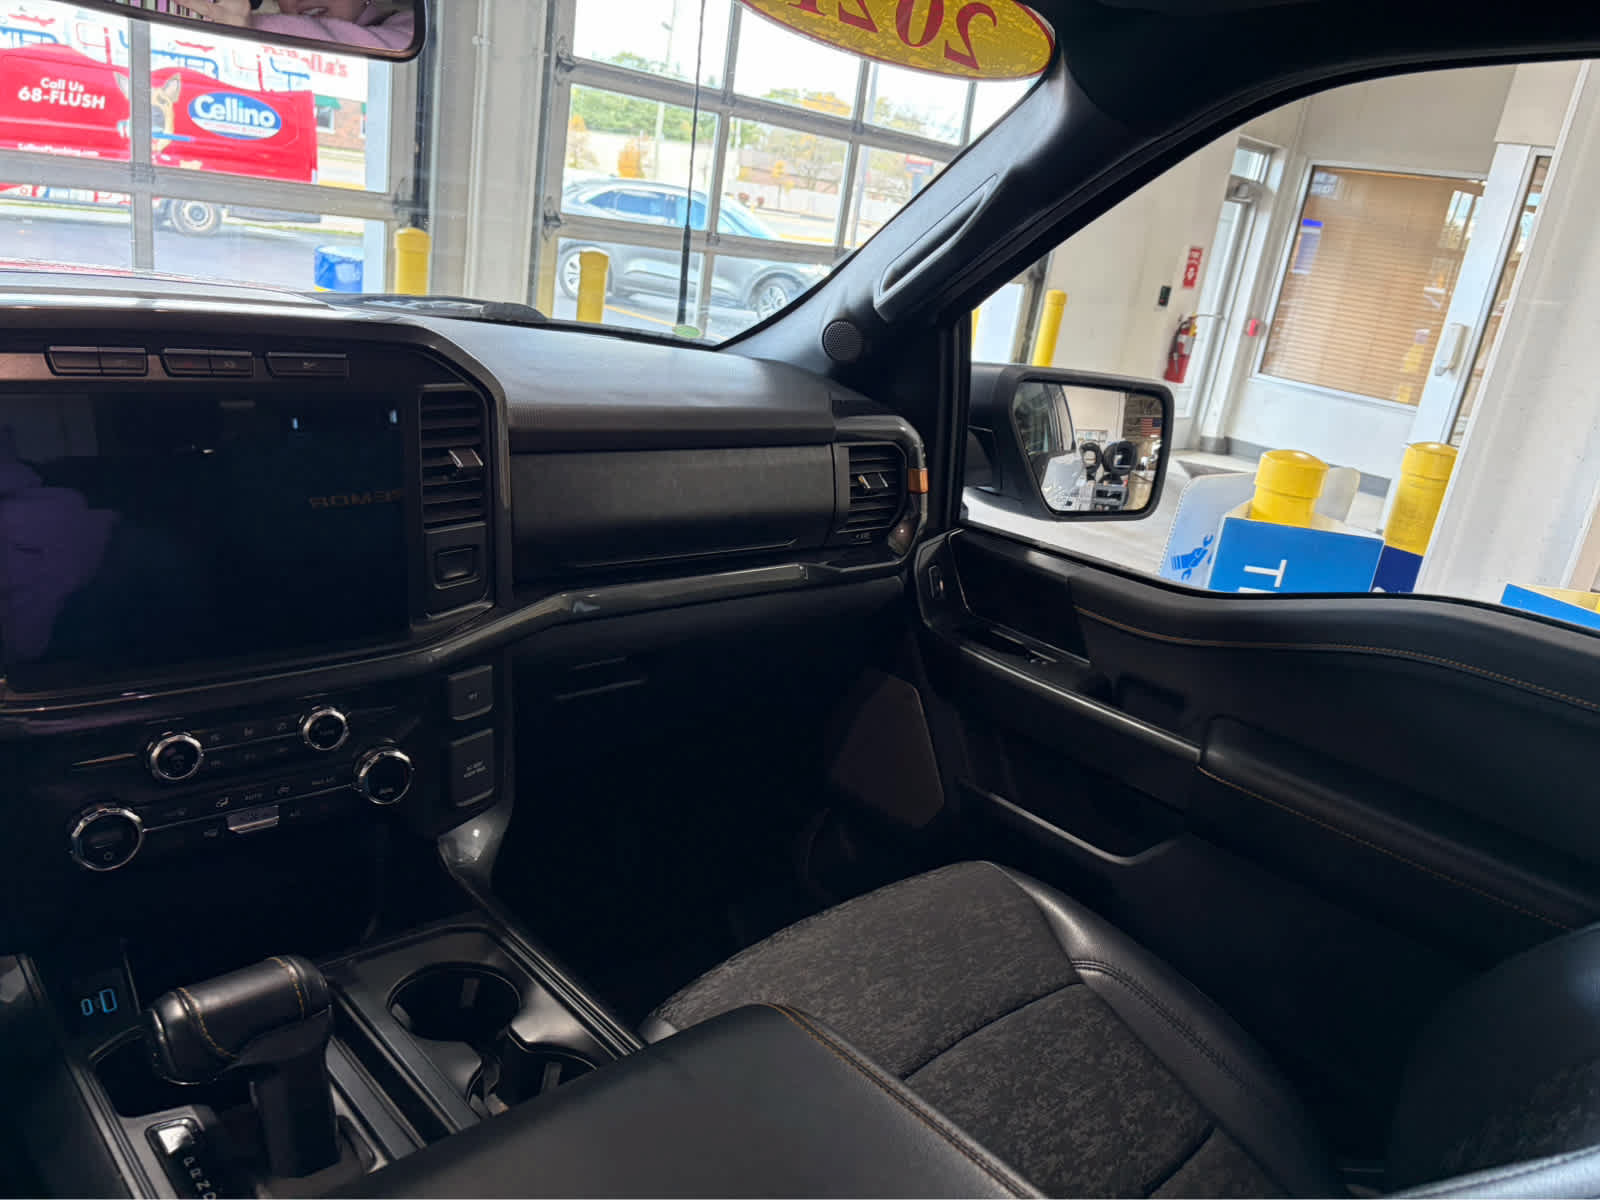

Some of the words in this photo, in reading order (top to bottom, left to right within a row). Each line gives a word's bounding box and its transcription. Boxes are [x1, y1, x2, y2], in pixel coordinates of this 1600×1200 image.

[40, 77, 66, 90] Call
[68, 80, 85, 92] Us
[18, 86, 106, 110] 68-FLUSH
[193, 93, 277, 129] Cellino
